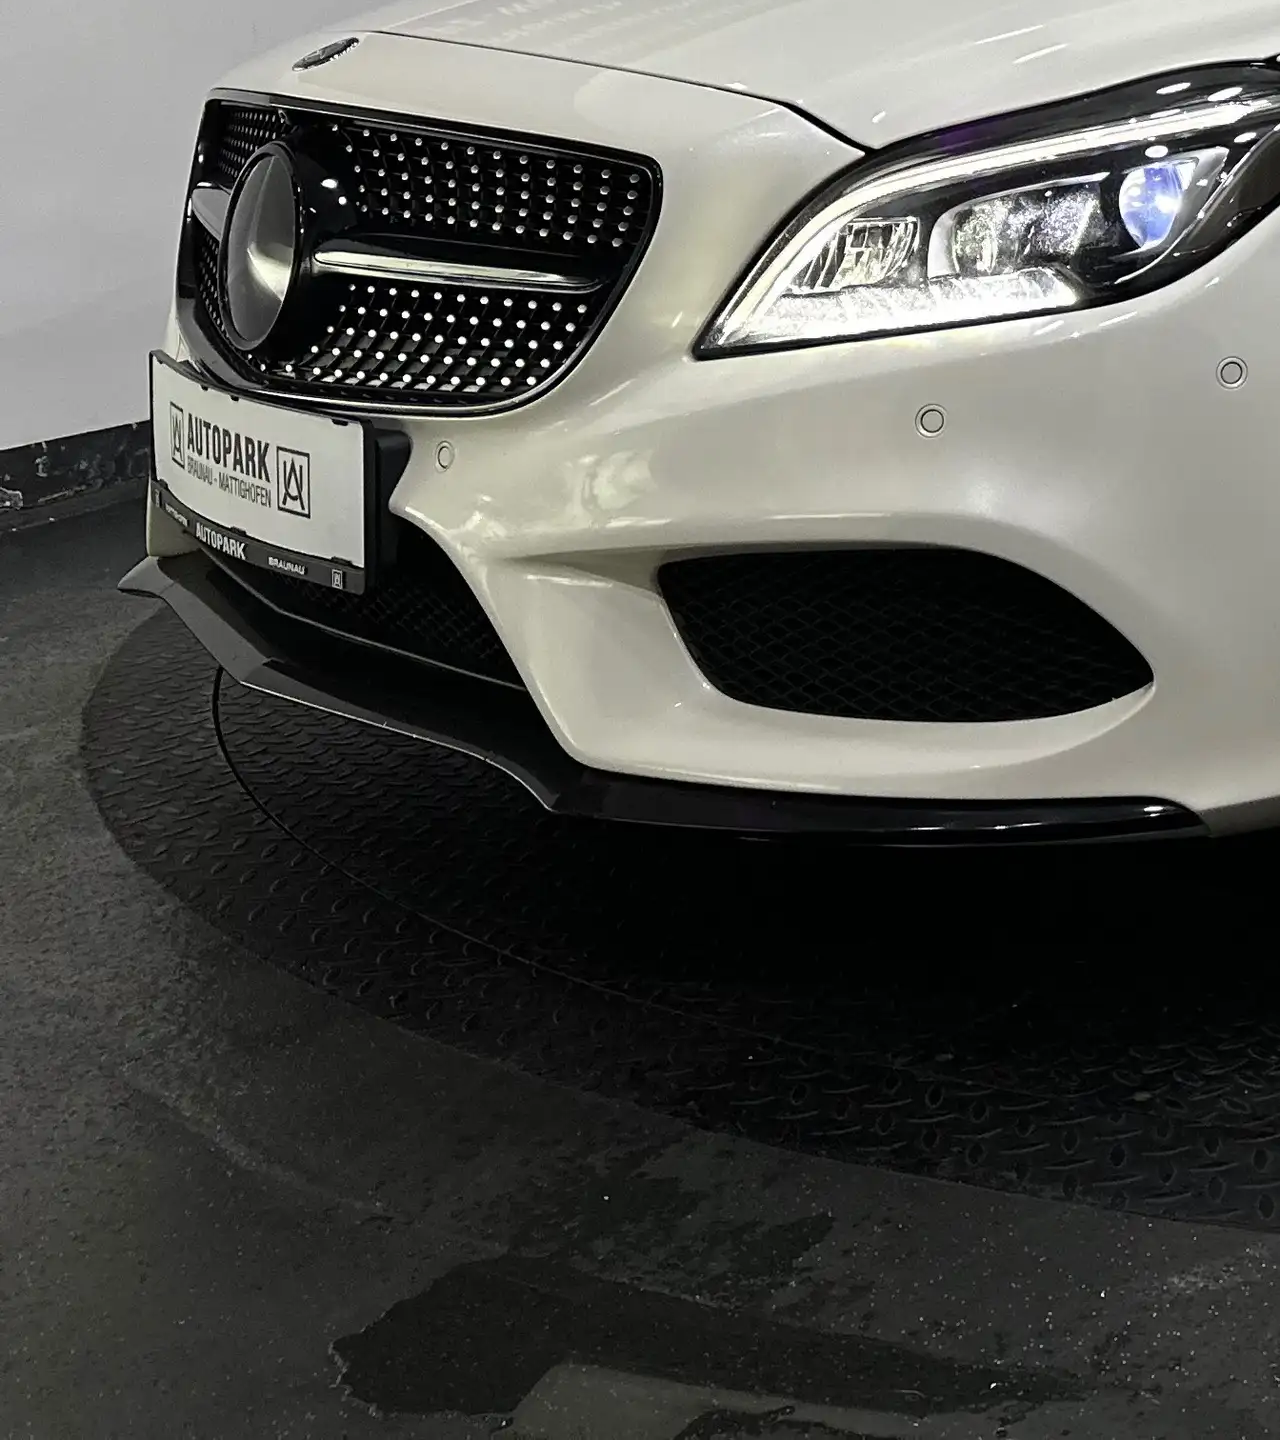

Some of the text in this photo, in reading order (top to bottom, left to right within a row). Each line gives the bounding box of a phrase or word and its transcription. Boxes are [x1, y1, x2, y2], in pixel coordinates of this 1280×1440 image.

[187, 412, 271, 483] AUTOPARK
[218, 472, 271, 508] MATTIGHOFEN
[195, 522, 305, 575] AUTOPARK BRAUNAU
